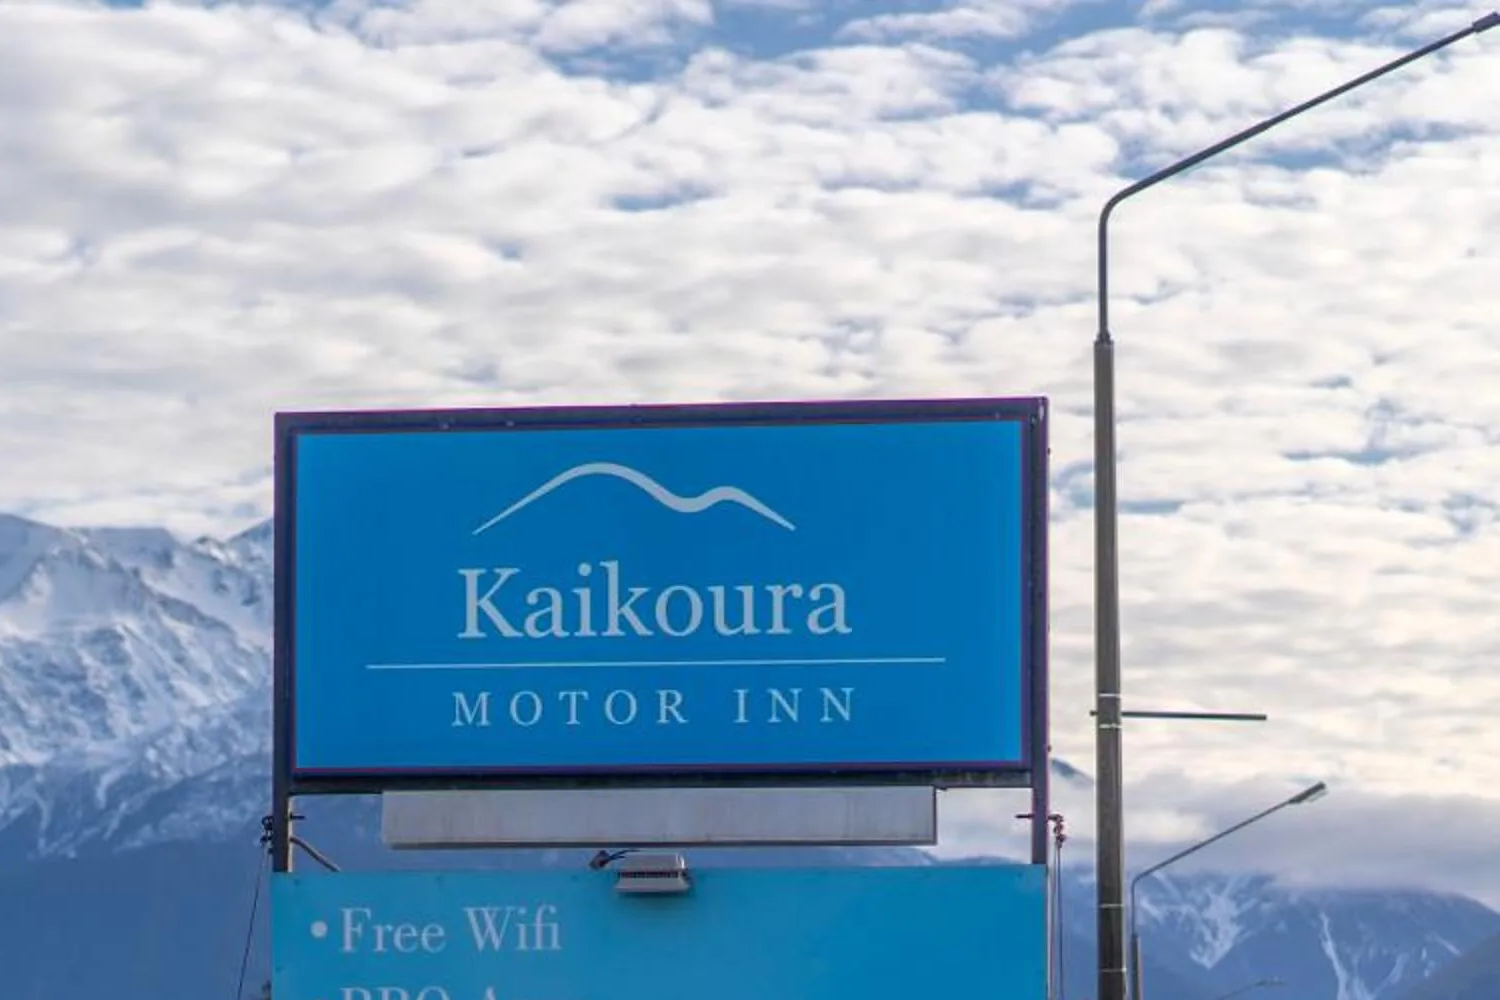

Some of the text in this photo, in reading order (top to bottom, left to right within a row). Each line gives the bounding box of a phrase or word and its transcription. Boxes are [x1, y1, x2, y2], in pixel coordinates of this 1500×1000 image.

[457, 560, 853, 639] Kaikoura
[452, 687, 854, 728] MOTOR INN
[342, 906, 562, 954] Free Wifi
